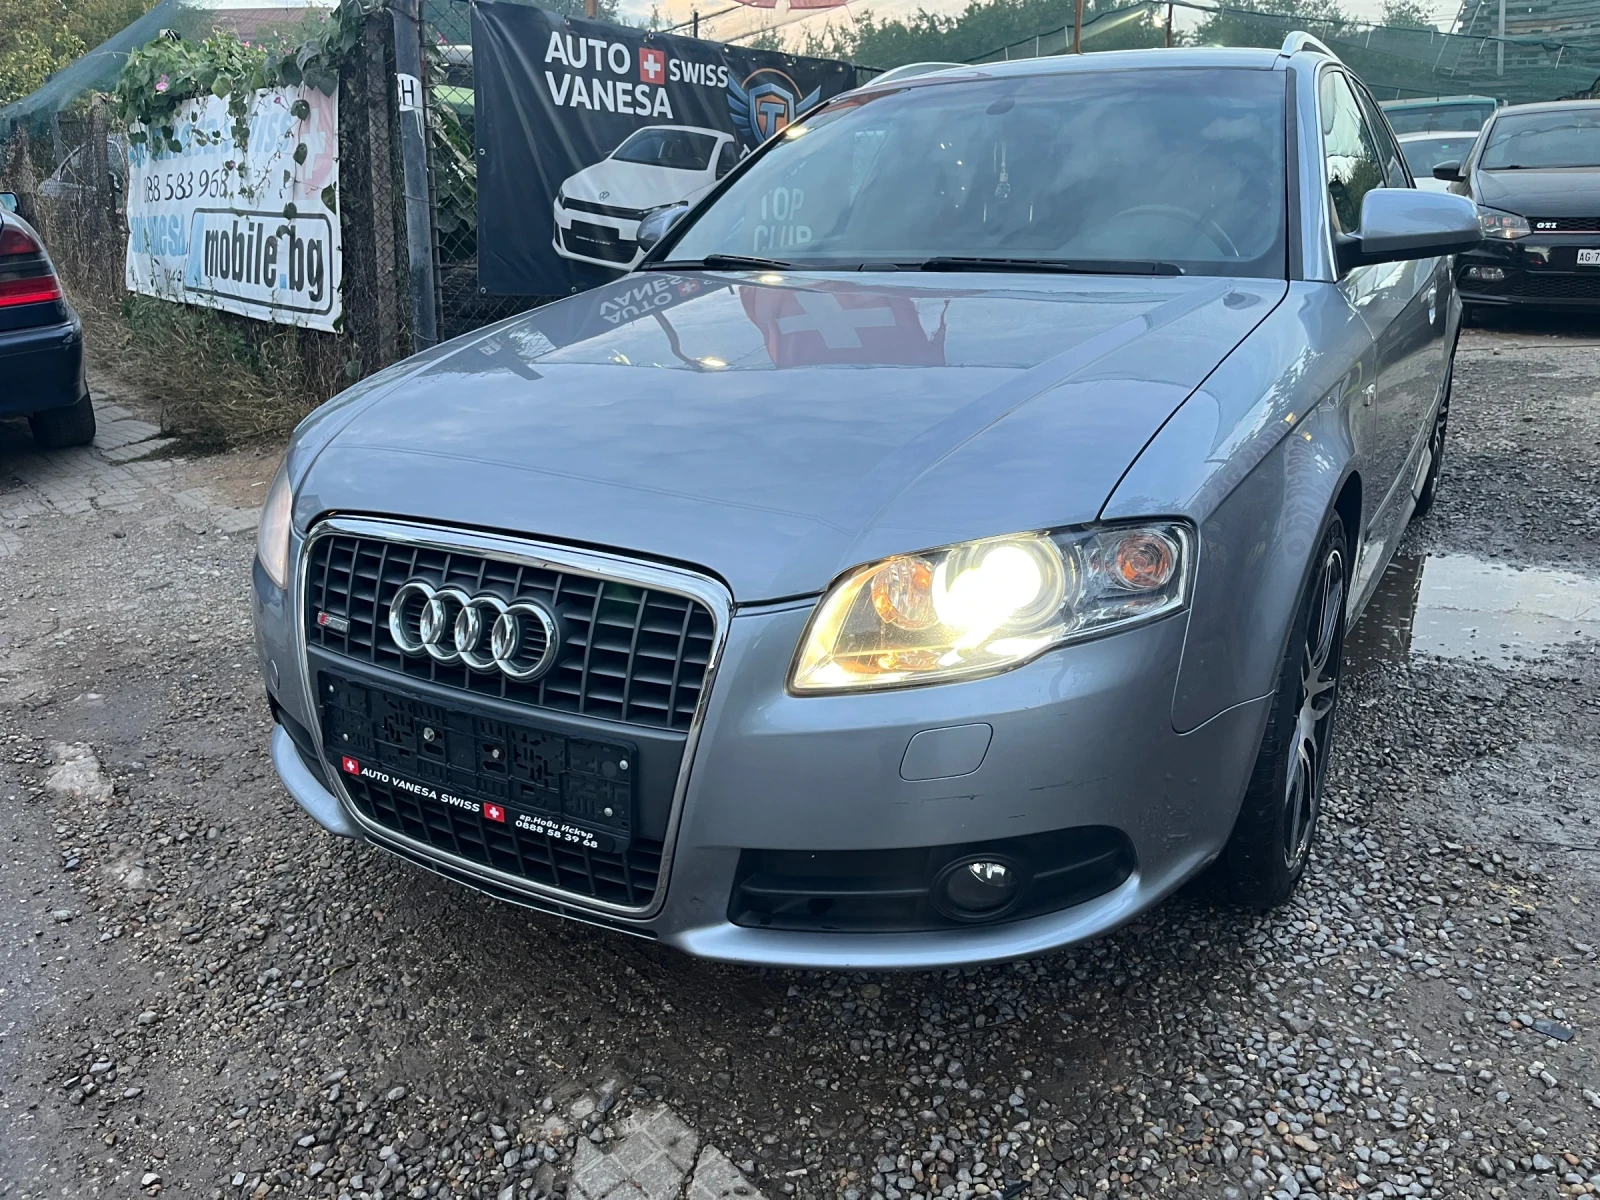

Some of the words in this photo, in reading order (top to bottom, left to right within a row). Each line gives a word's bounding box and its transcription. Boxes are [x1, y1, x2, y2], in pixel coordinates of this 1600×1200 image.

[544, 31, 631, 75] AUTO
[668, 58, 729, 88] SWISS
[544, 70, 674, 119] VANESA
[164, 170, 194, 201] 583
[198, 168, 229, 199] 968
[204, 219, 324, 302] mobile.bg
[360, 767, 390, 783] AUTO
[392, 776, 437, 800] VANESA
[440, 793, 481, 813] SWISS
[515, 820, 544, 834] 0888
[547, 828, 561, 839] 58
[564, 833, 580, 843] 39
[582, 839, 598, 849] 68
[561, 824, 594, 839] Искър
